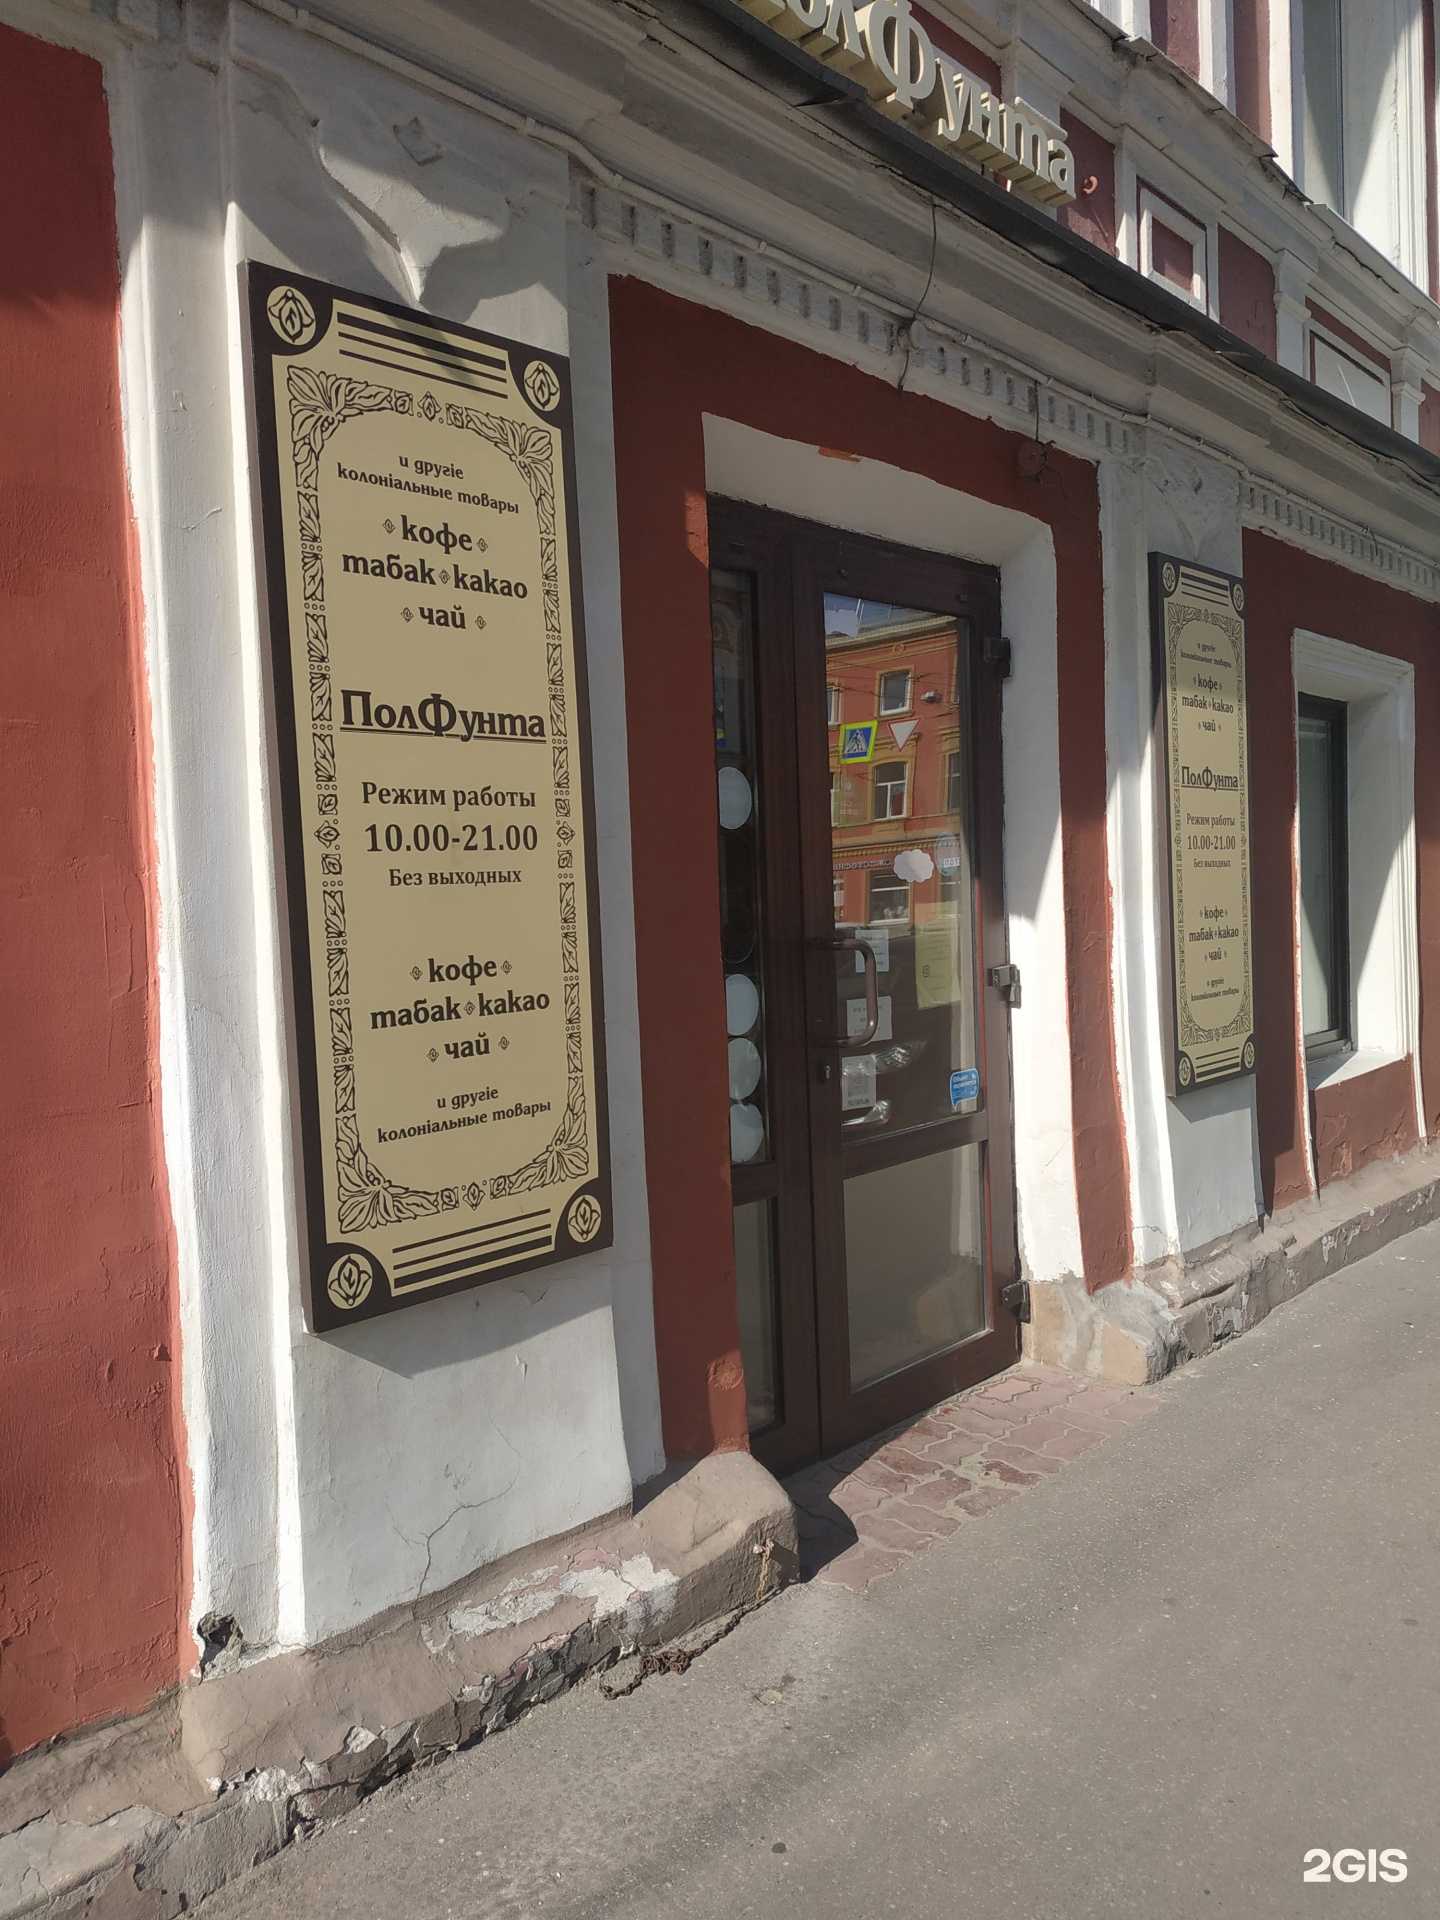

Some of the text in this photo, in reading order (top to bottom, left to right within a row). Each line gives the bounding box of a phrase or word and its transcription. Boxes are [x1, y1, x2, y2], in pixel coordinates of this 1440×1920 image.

[399, 456, 408, 467] и
[458, 492, 518, 514] товары
[401, 515, 472, 554] кофе
[342, 554, 527, 598] табак какао
[419, 605, 466, 629] чай
[340, 690, 546, 744] ПолФунта
[1181, 766, 1239, 792] ПолФунта
[362, 782, 535, 811] Режим работы
[365, 824, 537, 851] 10.00-21.00
[1187, 835, 1236, 850] 10.00-21.00
[389, 869, 521, 886] Без выходных
[428, 955, 497, 986] кофе
[370, 990, 549, 1029] табак какао
[444, 1032, 490, 1059] чай
[437, 1098, 446, 1108] и
[493, 1102, 550, 1121] товары
